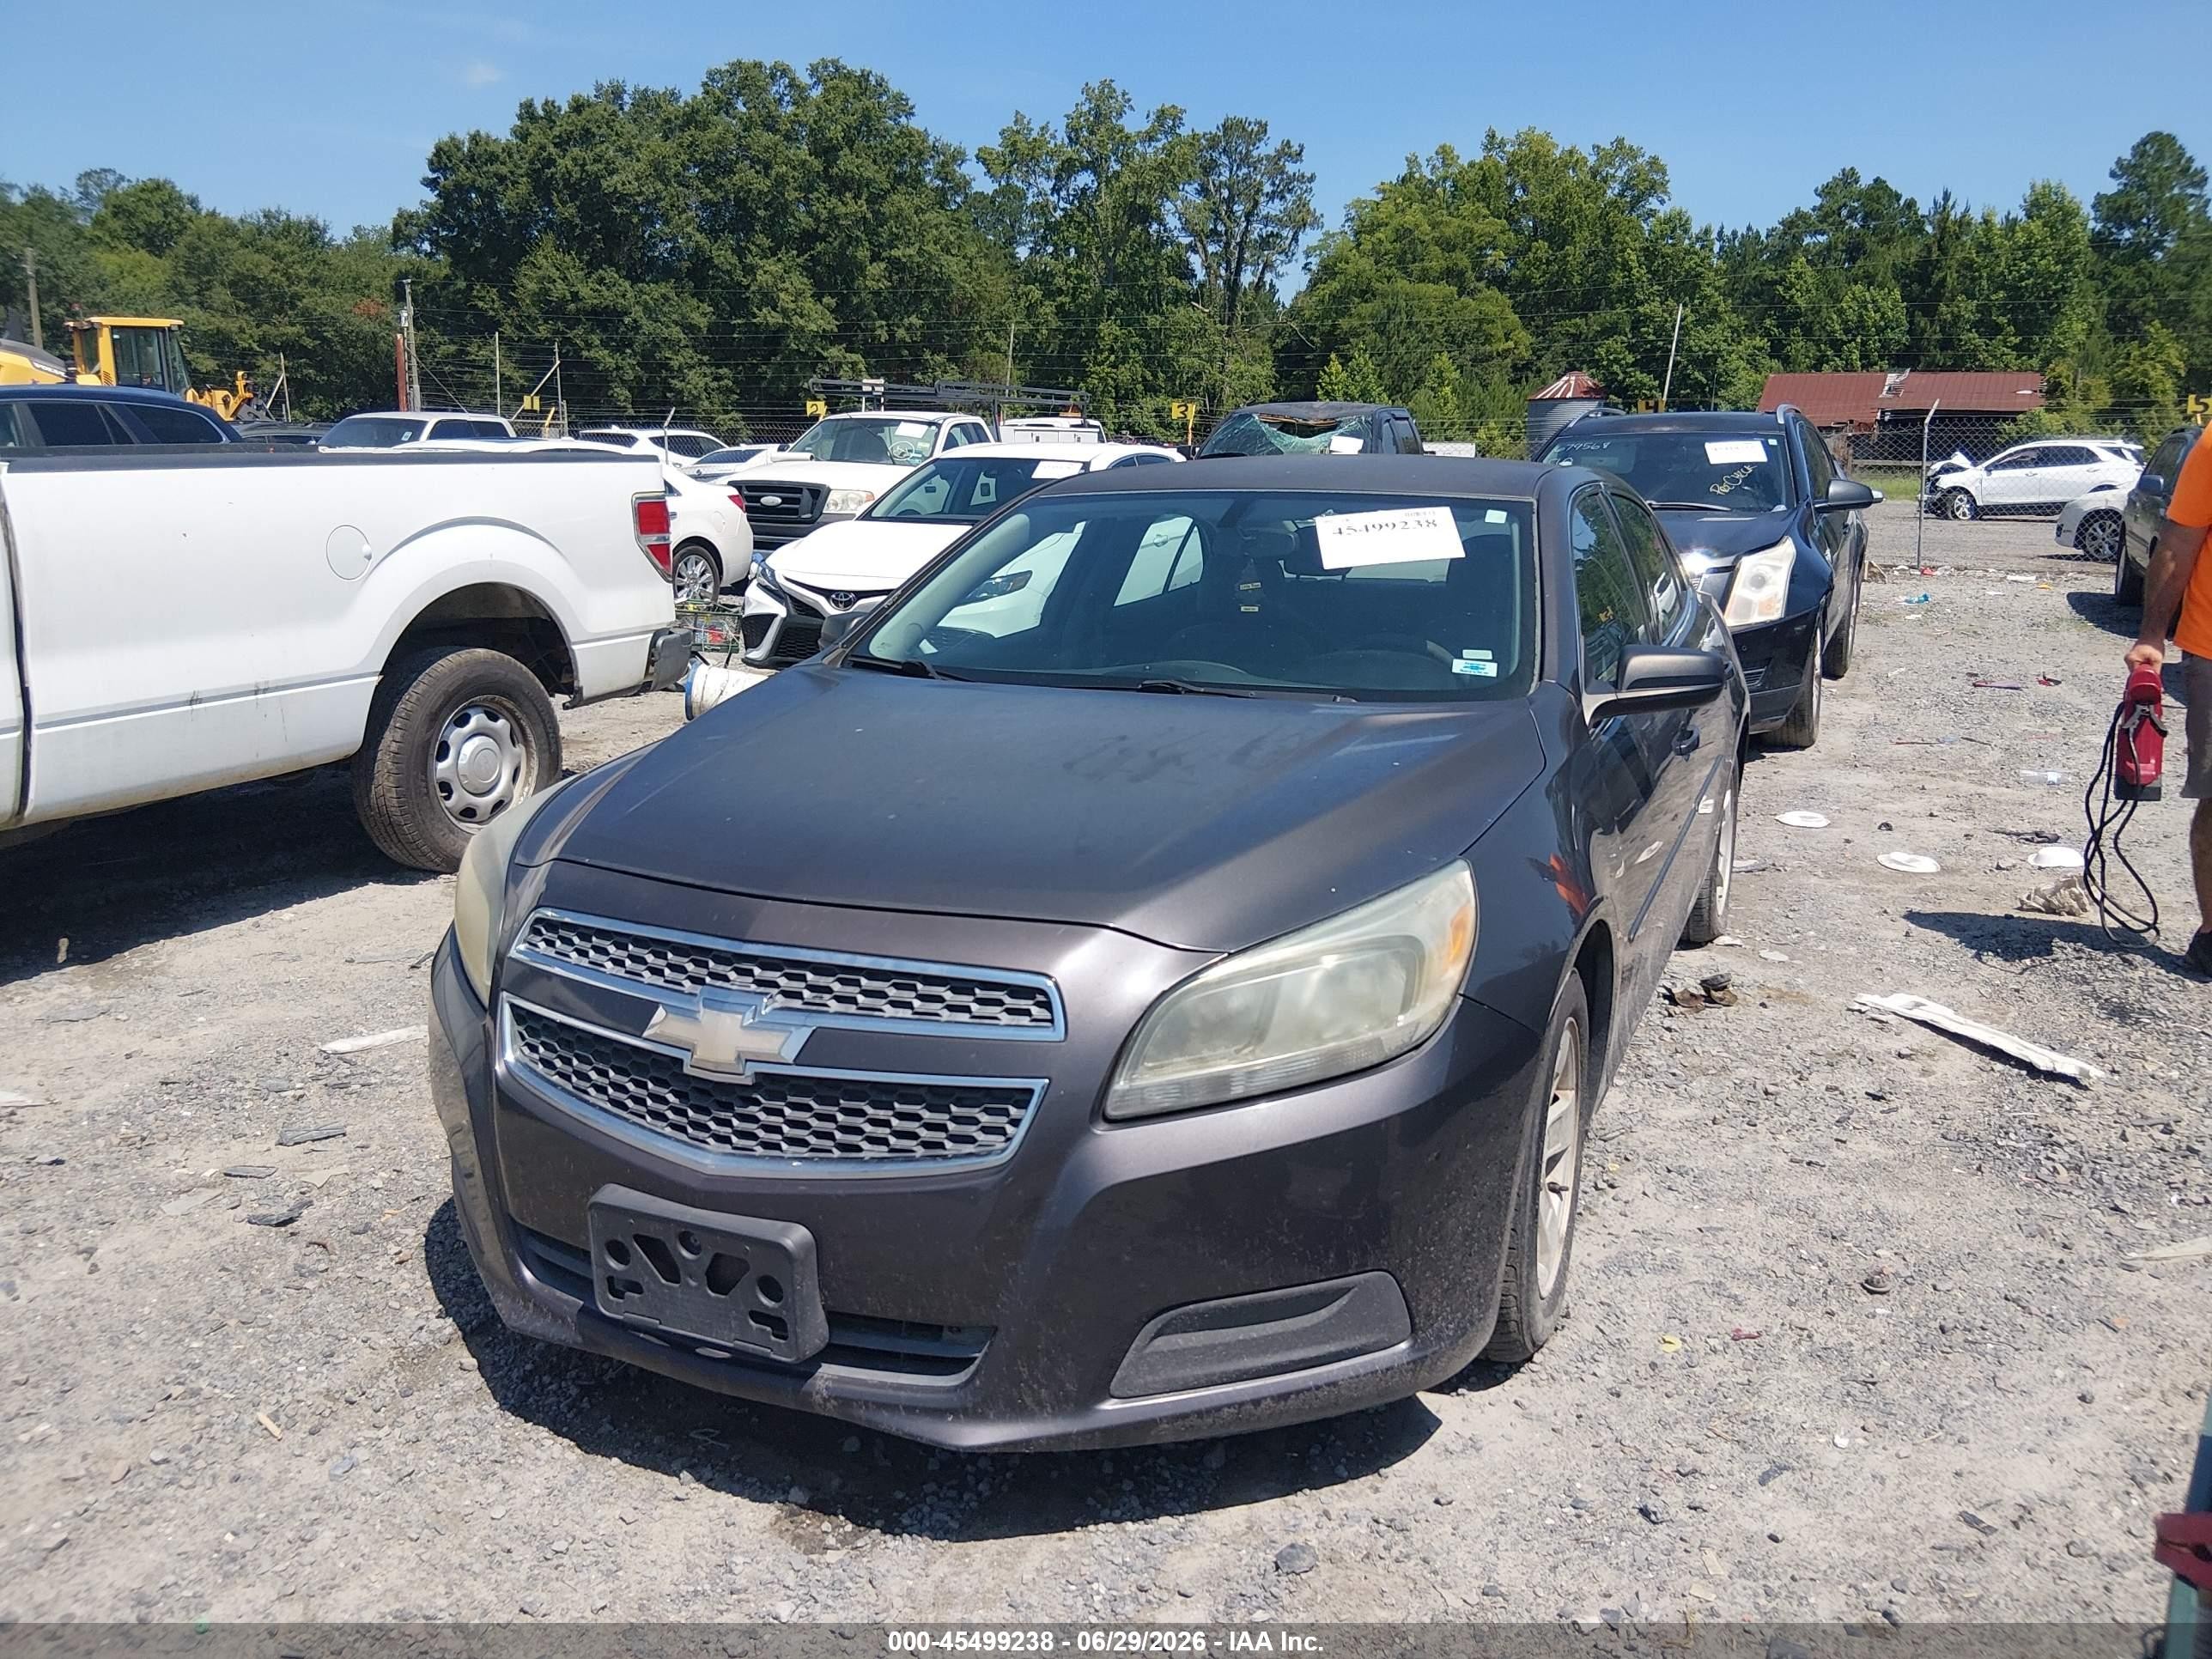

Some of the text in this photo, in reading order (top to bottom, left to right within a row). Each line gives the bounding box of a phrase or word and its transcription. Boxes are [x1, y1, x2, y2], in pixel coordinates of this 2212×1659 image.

[810, 404, 822, 416] 2
[1177, 404, 1188, 419] 3
[2191, 394, 2209, 414] 5
